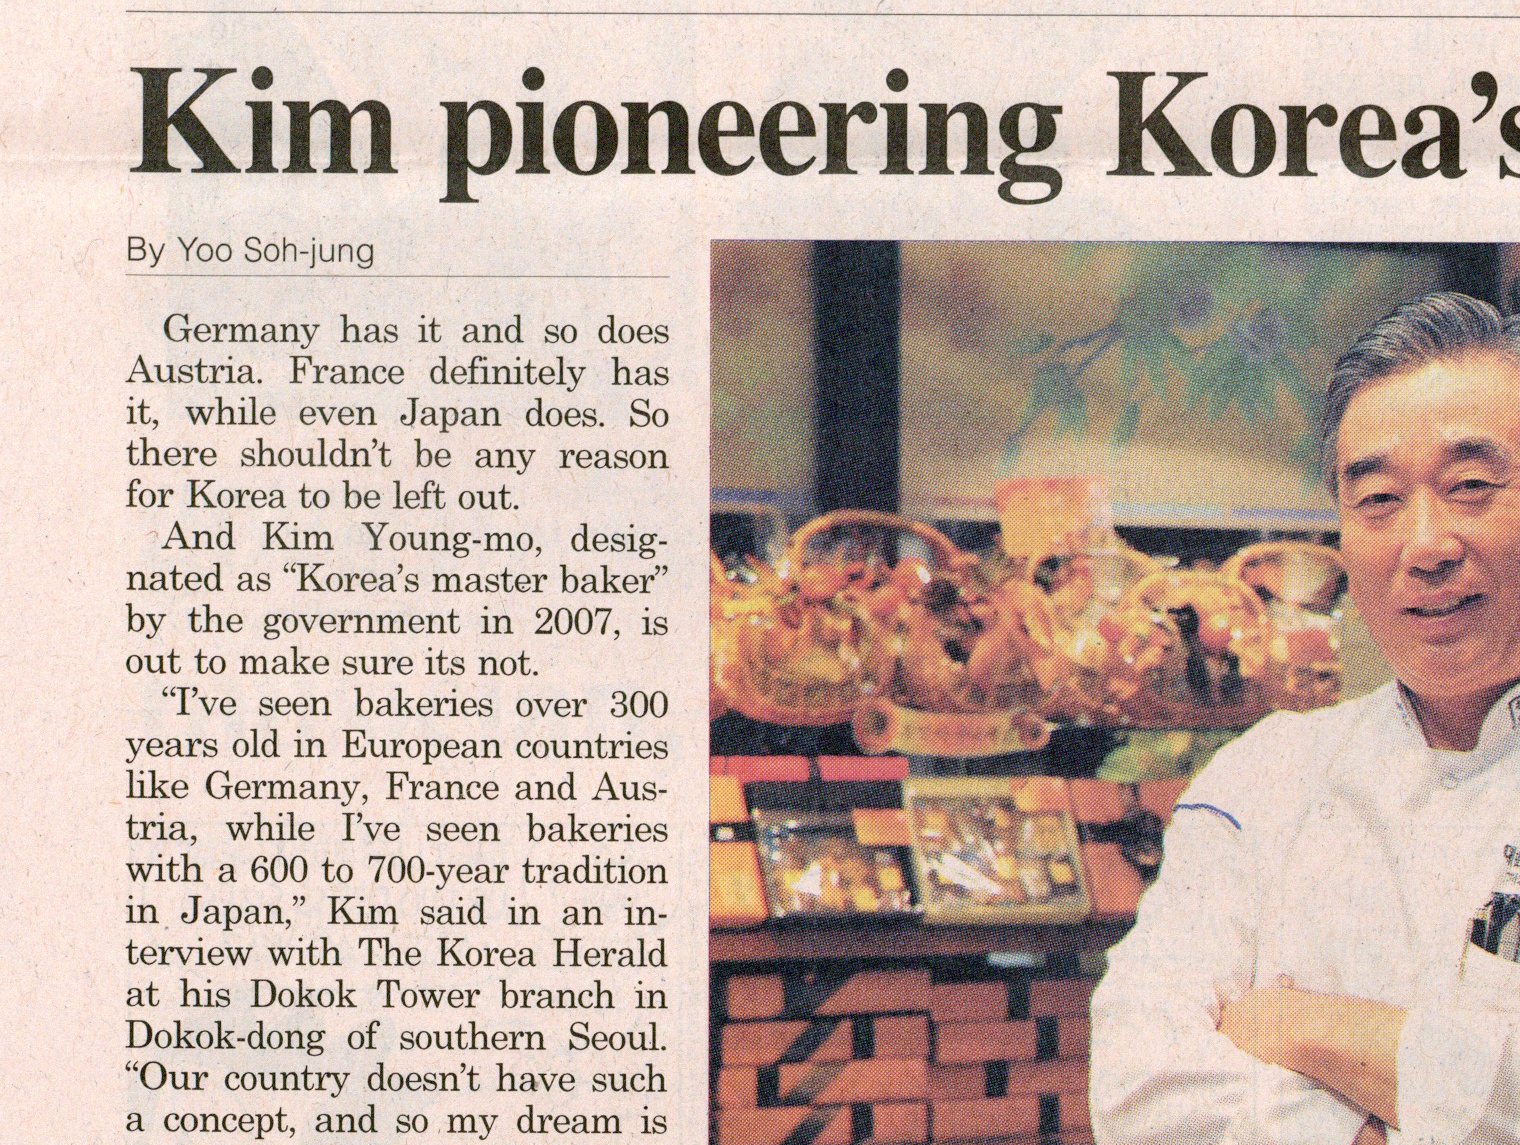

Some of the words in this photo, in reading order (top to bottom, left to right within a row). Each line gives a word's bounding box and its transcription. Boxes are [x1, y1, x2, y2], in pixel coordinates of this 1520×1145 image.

[129, 65, 399, 175] Kim
[438, 66, 1064, 205] pioneering
[127, 235, 166, 269] By
[176, 236, 233, 263] Yoo
[244, 236, 374, 270] Soh-jung
[124, 354, 263, 385] Austria.
[288, 355, 405, 385] France
[429, 355, 587, 393] definitely
[610, 356, 670, 386] has
[124, 602, 167, 640] by
[187, 603, 244, 634] the
[263, 608, 461, 641] government
[480, 605, 515, 635] in
[534, 607, 621, 641] 2007,
[641, 606, 669, 636] is
[125, 852, 204, 883] with
[217, 863, 238, 883] a
[250, 854, 309, 884] 600
[321, 856, 354, 884] to
[367, 855, 510, 891] 700-year
[521, 854, 669, 885] tradition
